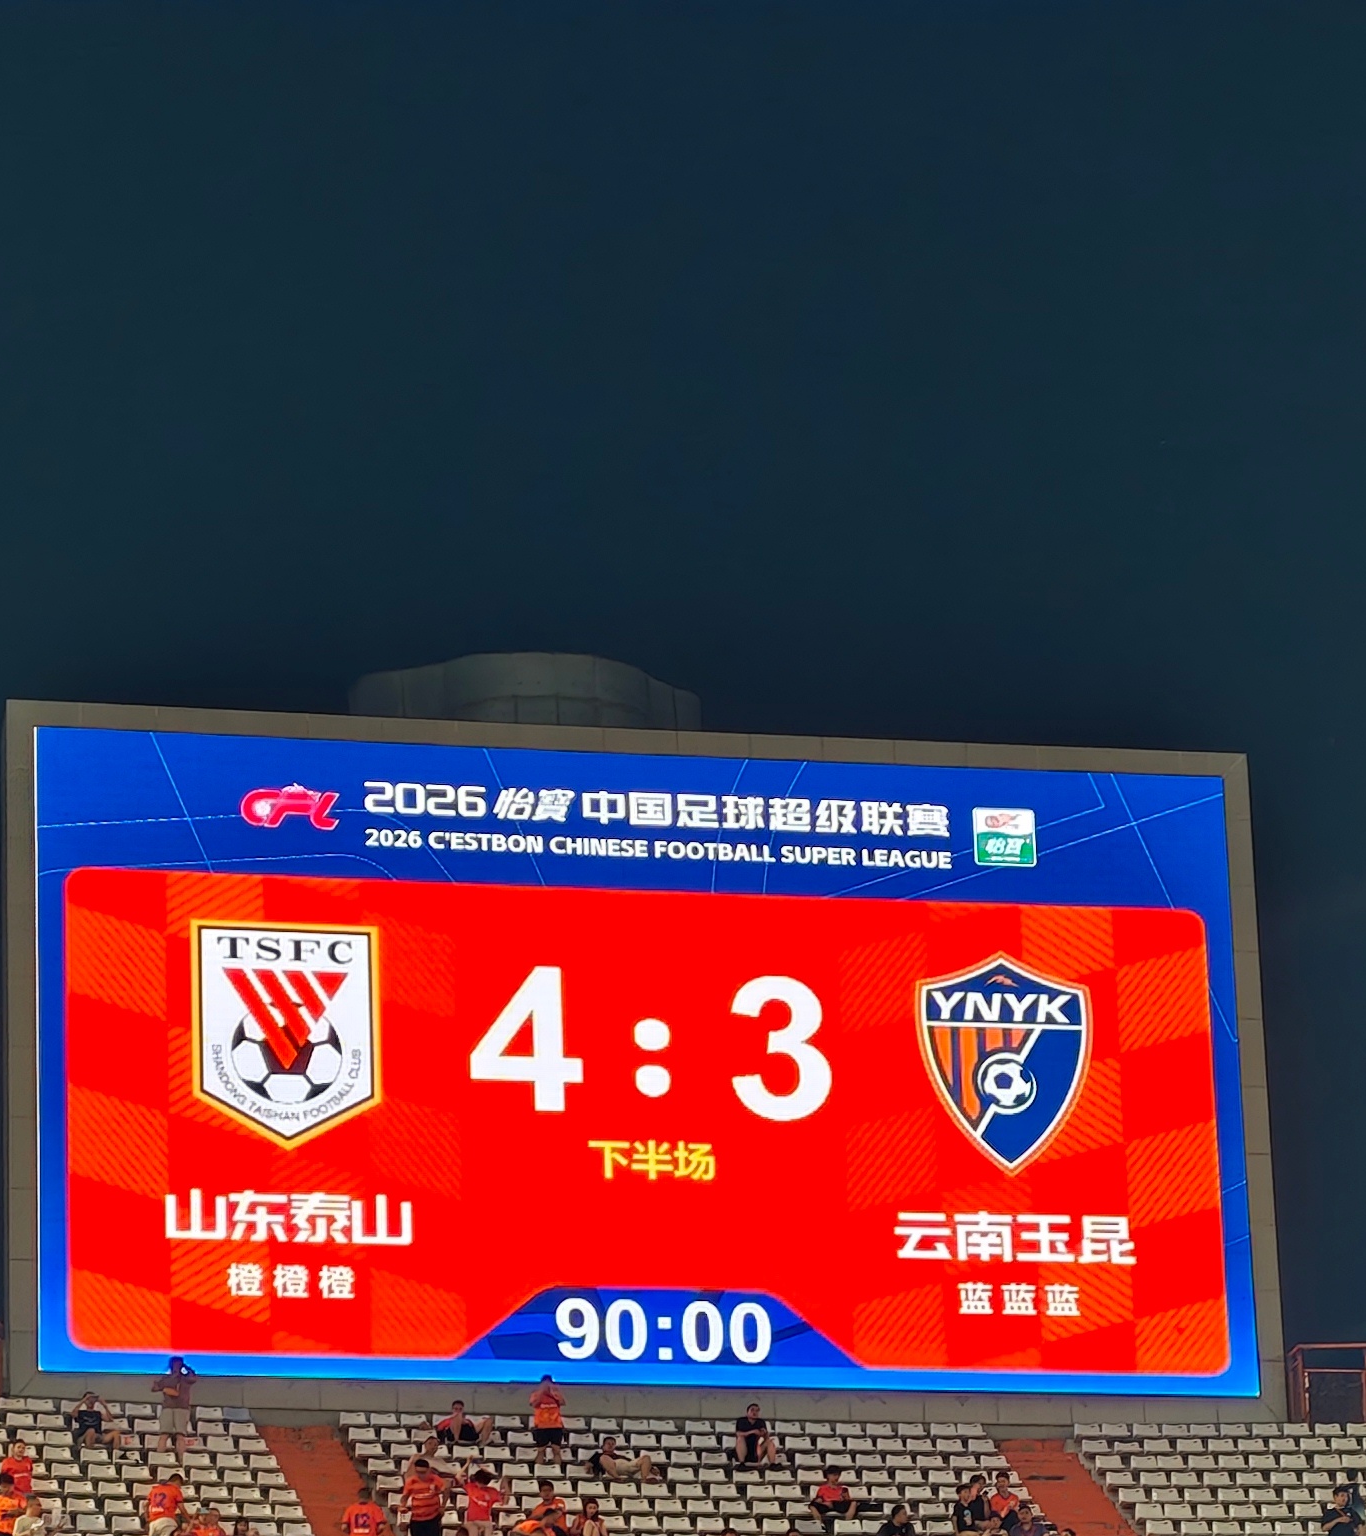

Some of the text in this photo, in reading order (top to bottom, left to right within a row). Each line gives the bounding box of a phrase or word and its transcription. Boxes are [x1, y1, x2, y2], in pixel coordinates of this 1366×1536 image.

[363, 780, 488, 818] 2026
[582, 789, 951, 838] 中国足球超级联赛
[364, 828, 953, 870] 2026 C'ESTBON CHINESE FOOTBALL SUPER LEAGUE
[217, 936, 353, 965] TSFC
[928, 987, 1074, 1026] YNYK
[211, 1044, 362, 1122] SHANDONG TAISHAN FOOTBALL CLUB
[588, 1140, 717, 1184] 下半场
[164, 1190, 415, 1248] 山东泰山
[893, 1211, 1139, 1268] 云南玉昆
[553, 1297, 774, 1366] 90:00
